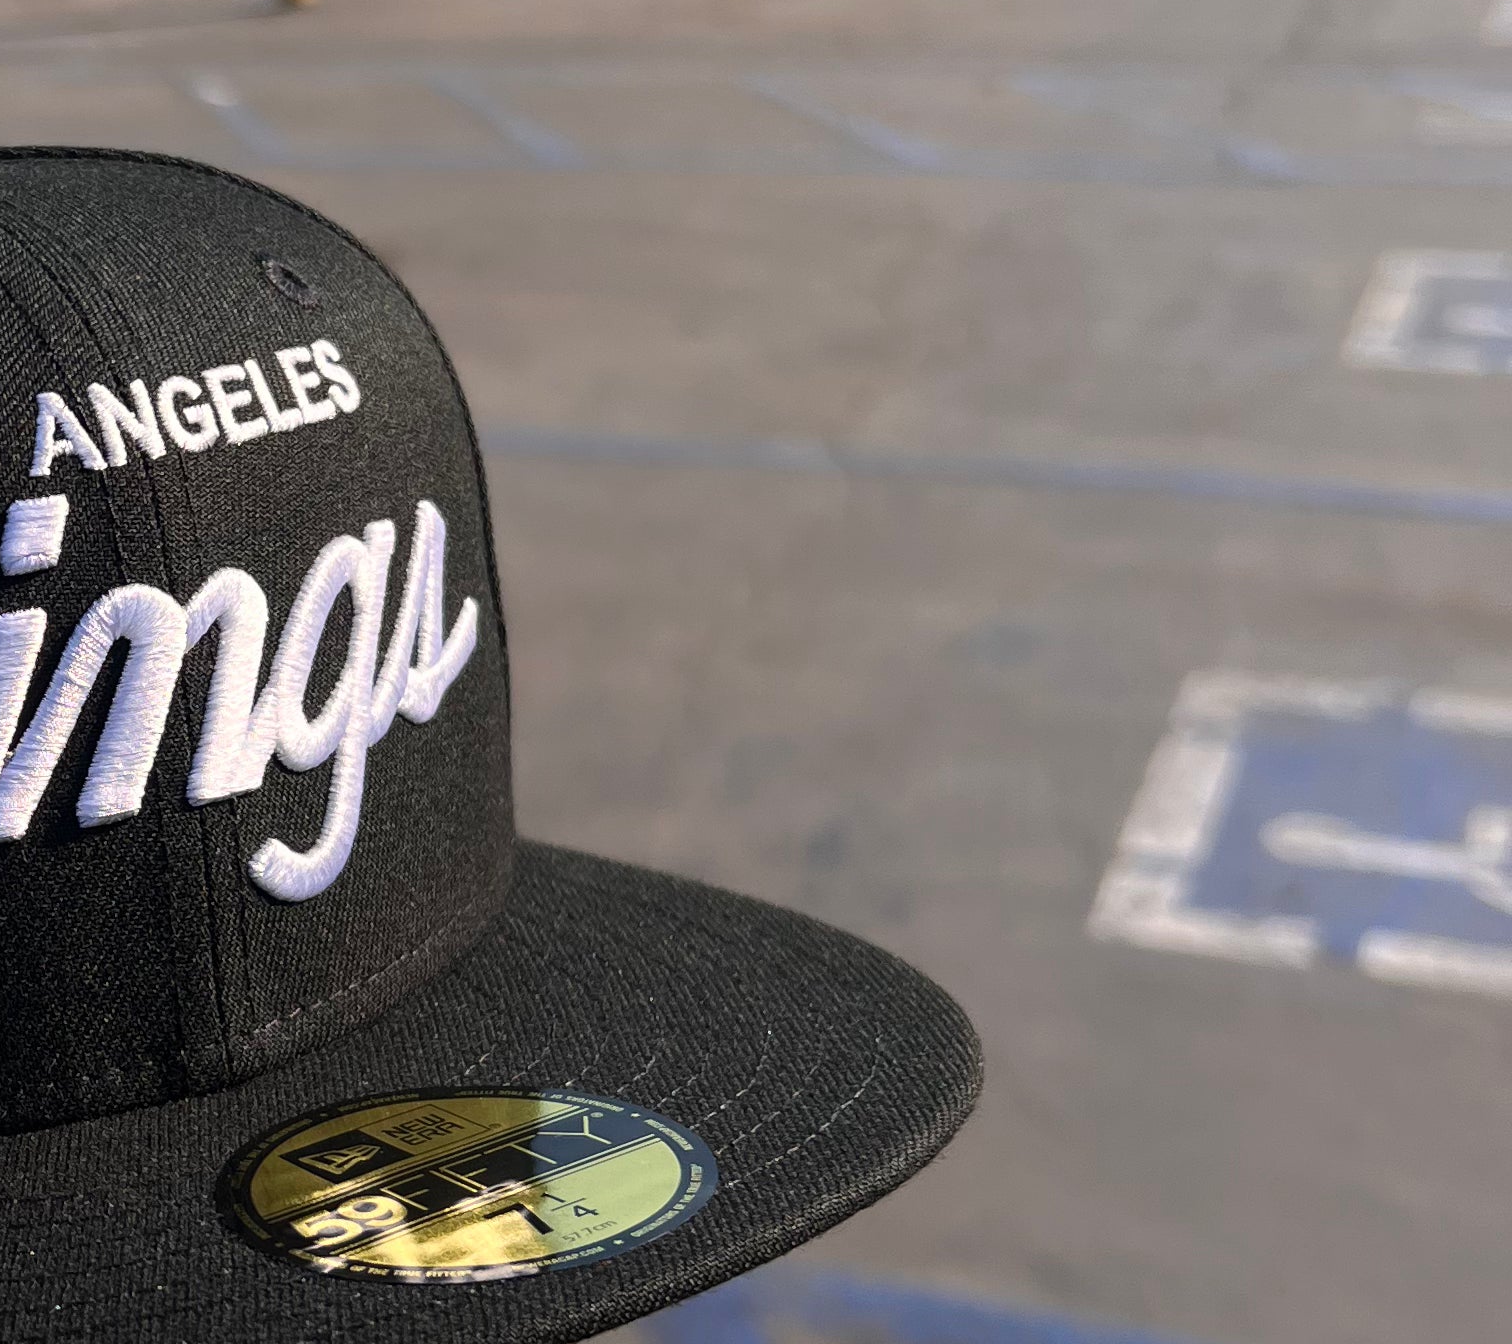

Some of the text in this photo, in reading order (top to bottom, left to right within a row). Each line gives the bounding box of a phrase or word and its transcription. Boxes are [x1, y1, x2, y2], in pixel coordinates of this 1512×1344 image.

[29, 339, 363, 478] ANGELES
[381, 1113, 445, 1138] NEW
[400, 1121, 465, 1146] ERA
